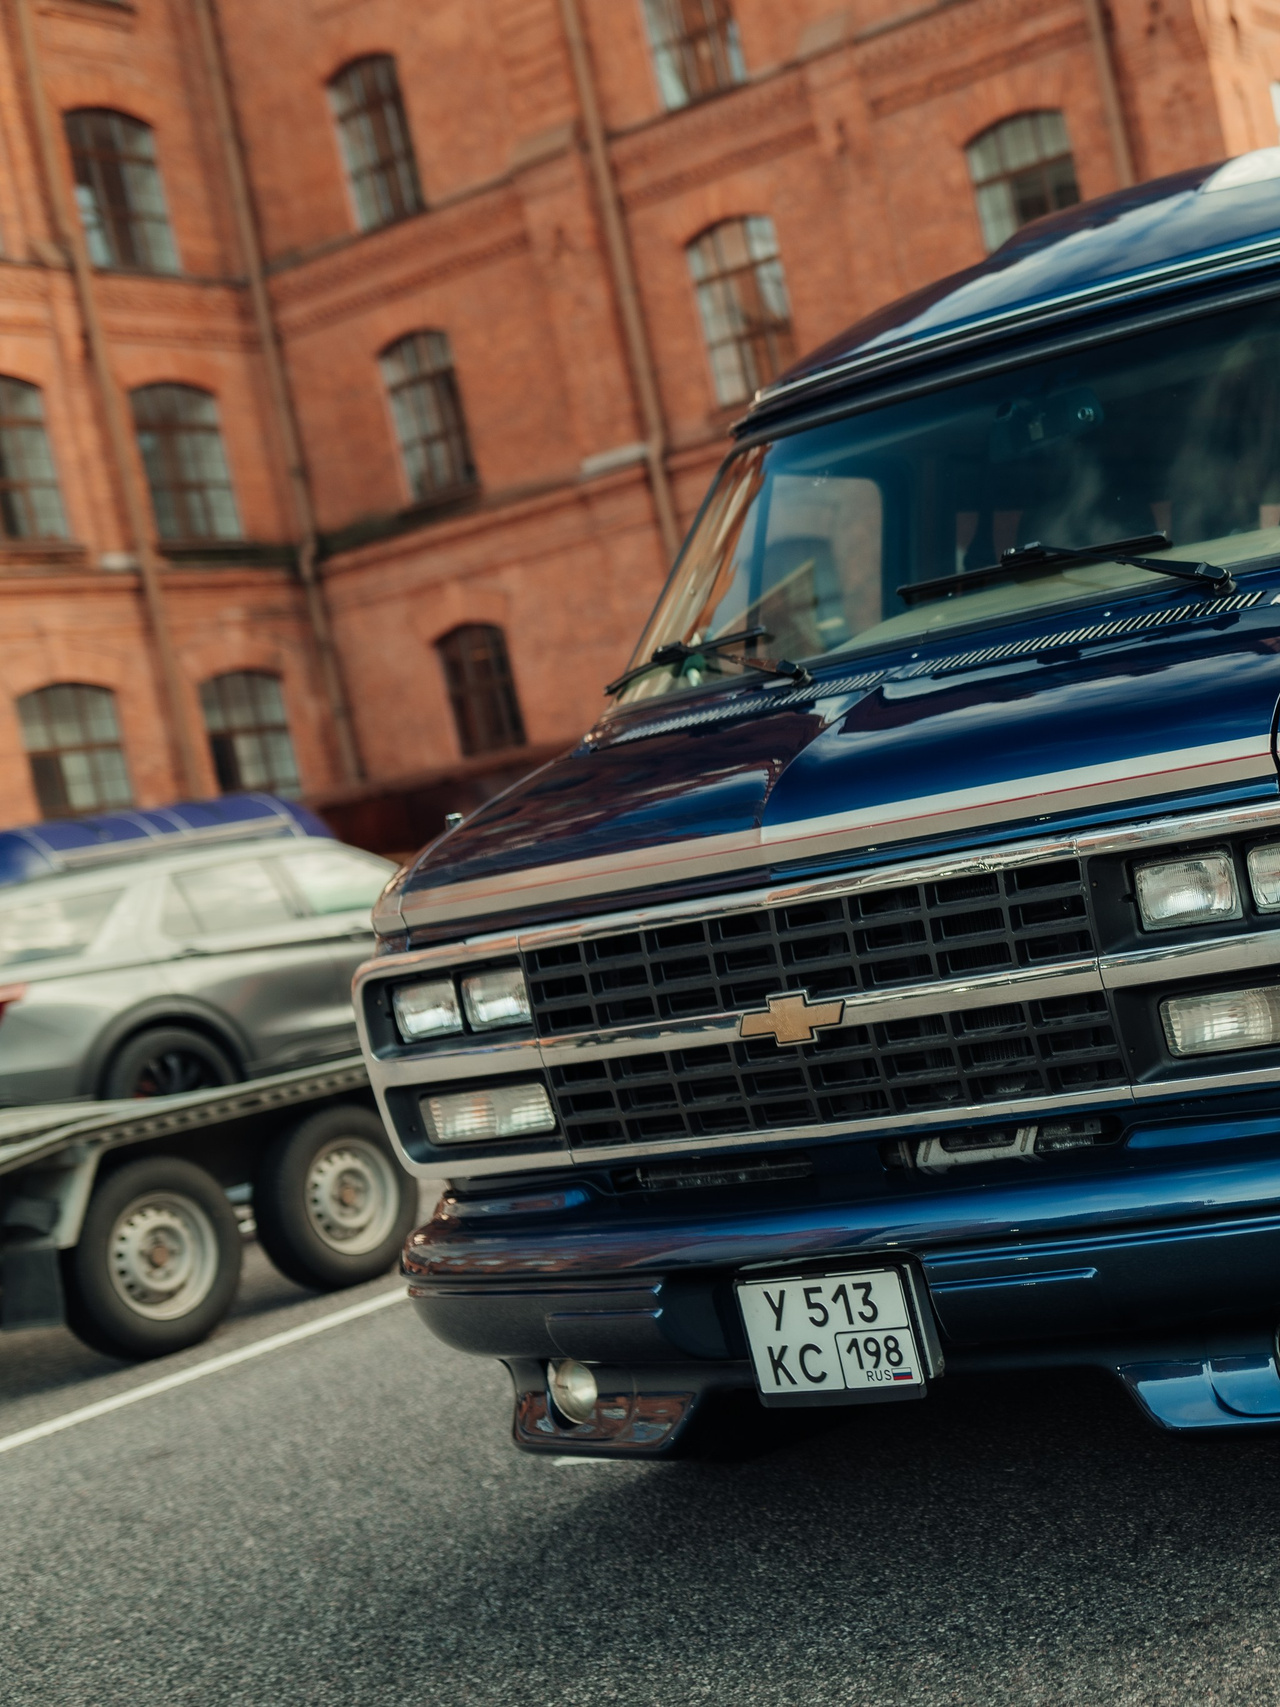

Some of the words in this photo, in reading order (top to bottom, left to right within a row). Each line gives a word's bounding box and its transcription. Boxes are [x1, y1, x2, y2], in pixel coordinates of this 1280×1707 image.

[802, 1281, 879, 1327] 513
[846, 1335, 904, 1370] 198
[866, 1370, 892, 1382] RUS
